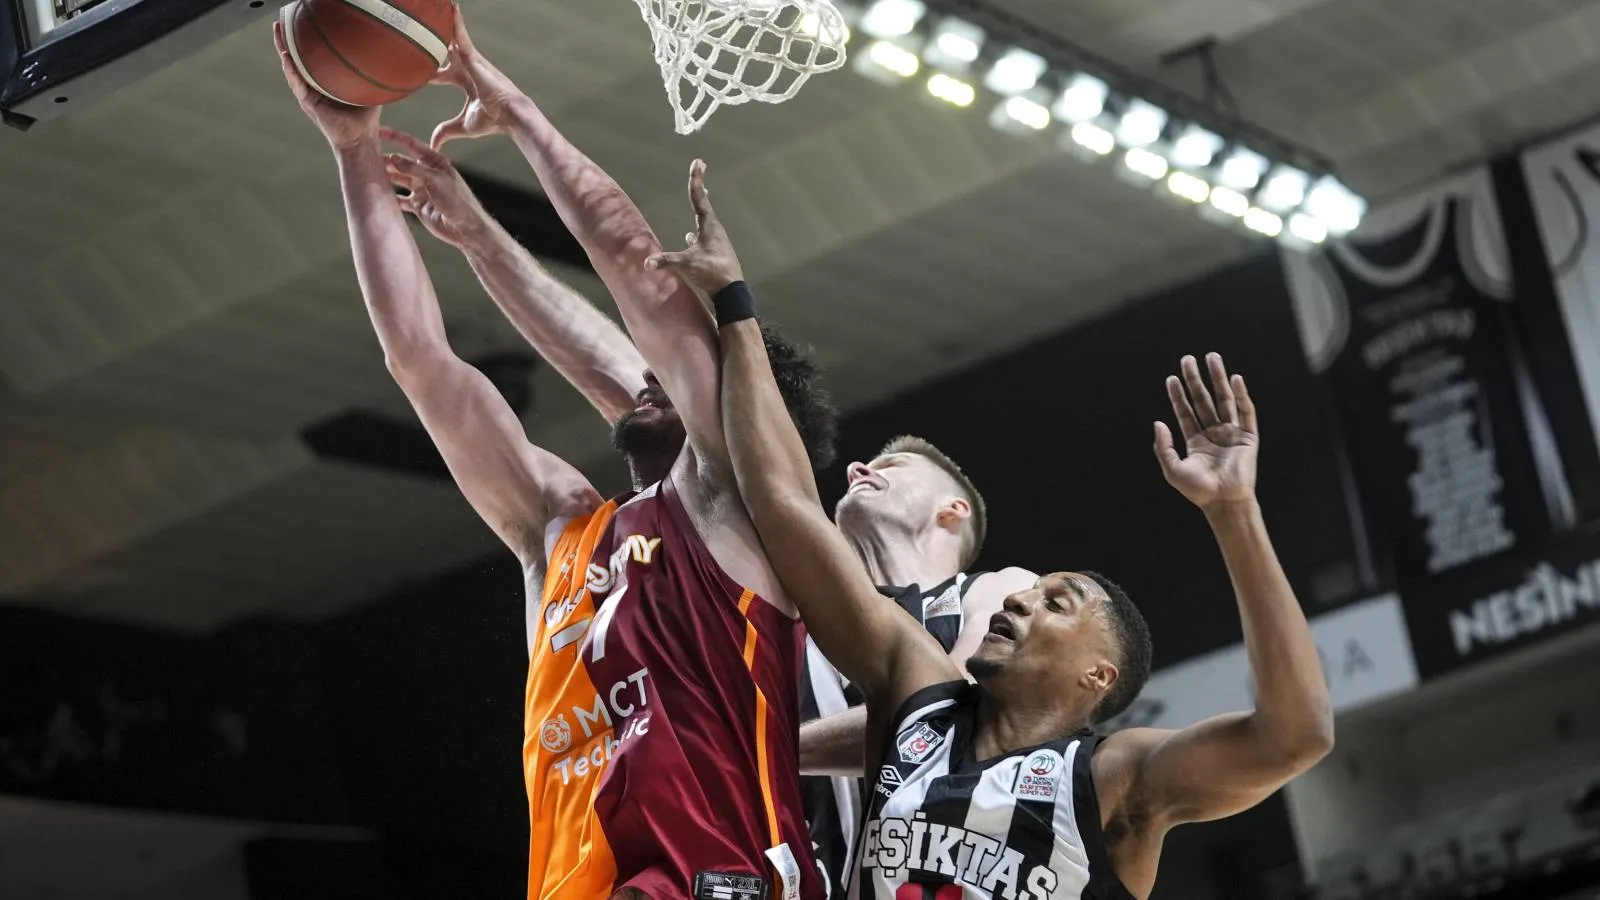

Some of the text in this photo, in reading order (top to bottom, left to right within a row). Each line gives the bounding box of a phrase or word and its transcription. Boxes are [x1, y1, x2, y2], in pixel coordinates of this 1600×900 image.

[1449, 556, 1600, 656] NESİN
[571, 667, 649, 739] MCT
[553, 717, 650, 785] Techic
